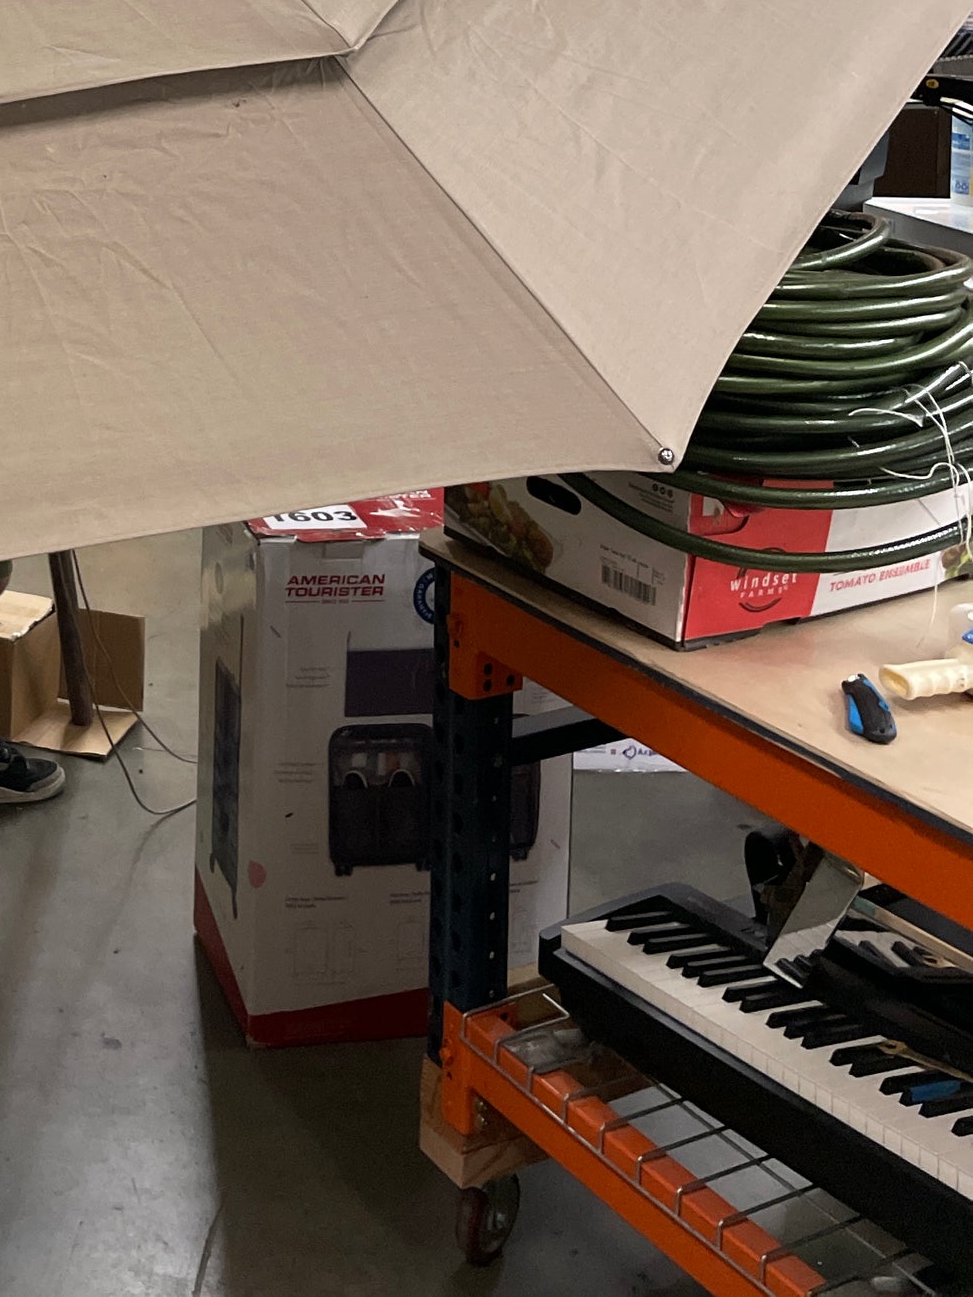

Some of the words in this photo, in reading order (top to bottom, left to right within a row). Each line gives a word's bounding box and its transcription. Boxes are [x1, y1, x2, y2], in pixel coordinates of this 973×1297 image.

[287, 574, 385, 586] AMERICAN
[829, 573, 876, 592] TOMATO
[879, 559, 930, 582] ENSEMBLE
[285, 586, 384, 597] TOURISTER
